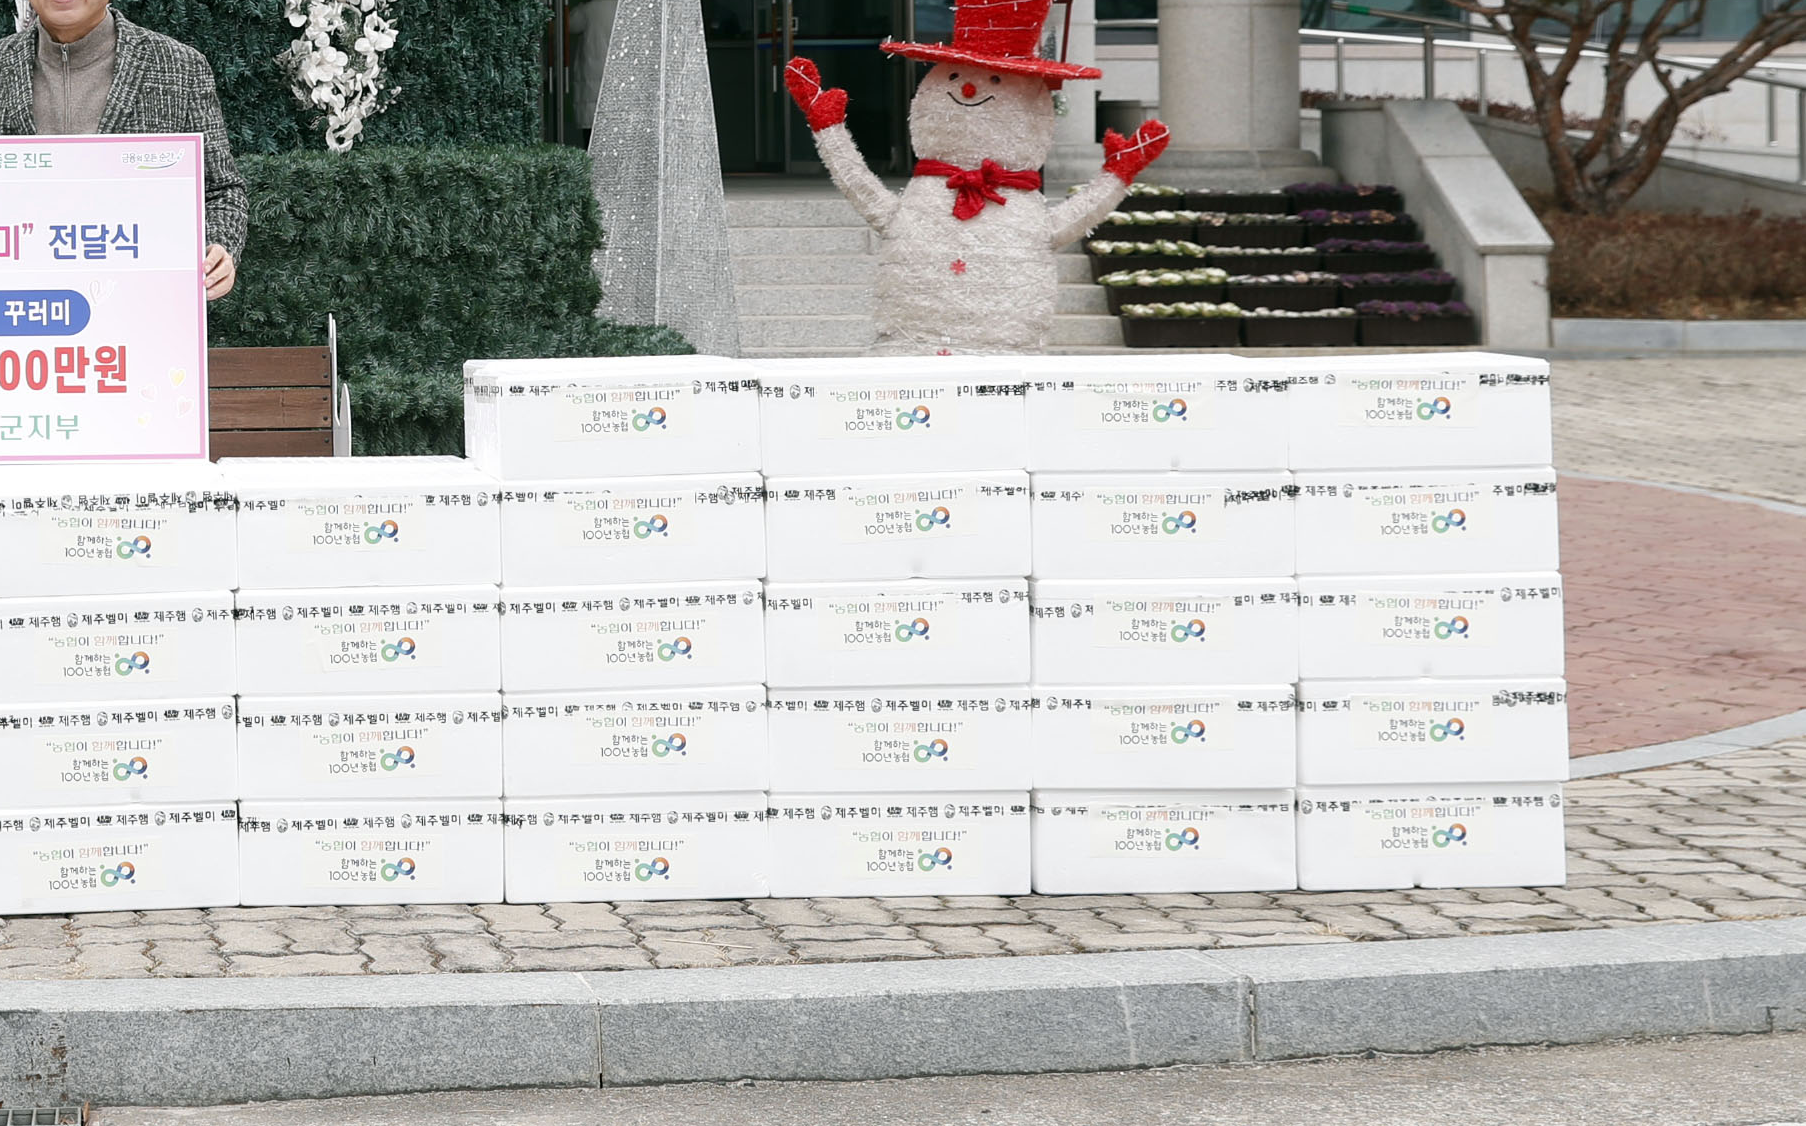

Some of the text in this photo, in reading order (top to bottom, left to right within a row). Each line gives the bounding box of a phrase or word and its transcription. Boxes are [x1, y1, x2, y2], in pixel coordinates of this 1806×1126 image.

[22, 152, 54, 169] 진도
[48, 223, 140, 261] 전달식
[4, 299, 70, 327] 꾸러미
[1112, 399, 1149, 411] 함께하는
[591, 409, 628, 422] 함께하는
[855, 407, 892, 420] 함께하는
[593, 516, 630, 529] 함께하는
[874, 510, 912, 523] 함께하는
[1122, 511, 1158, 523] 함께하는
[1391, 511, 1428, 524] 함께하는
[323, 521, 360, 534] 함께하는
[76, 535, 113, 547] 함께하는
[854, 620, 891, 632] 함께하는
[1131, 618, 1167, 630] 함께하는
[1393, 615, 1430, 627] 함께하는
[340, 640, 377, 652] 함께하는
[616, 639, 653, 652] 함께하는
[74, 653, 111, 666] 함께하는
[1130, 721, 1167, 734] 함께하는
[1389, 718, 1426, 730] 함께하는
[611, 734, 648, 746] 함께하는
[873, 739, 910, 751] 함께하는
[339, 749, 376, 762] 함께하는
[72, 758, 109, 771] 함께하는
[1125, 827, 1162, 839] 함께하는
[1391, 825, 1428, 837] 함께하는
[877, 848, 914, 860] 함께하는
[340, 858, 377, 870] 함께하는
[59, 865, 96, 878] 함께하는
